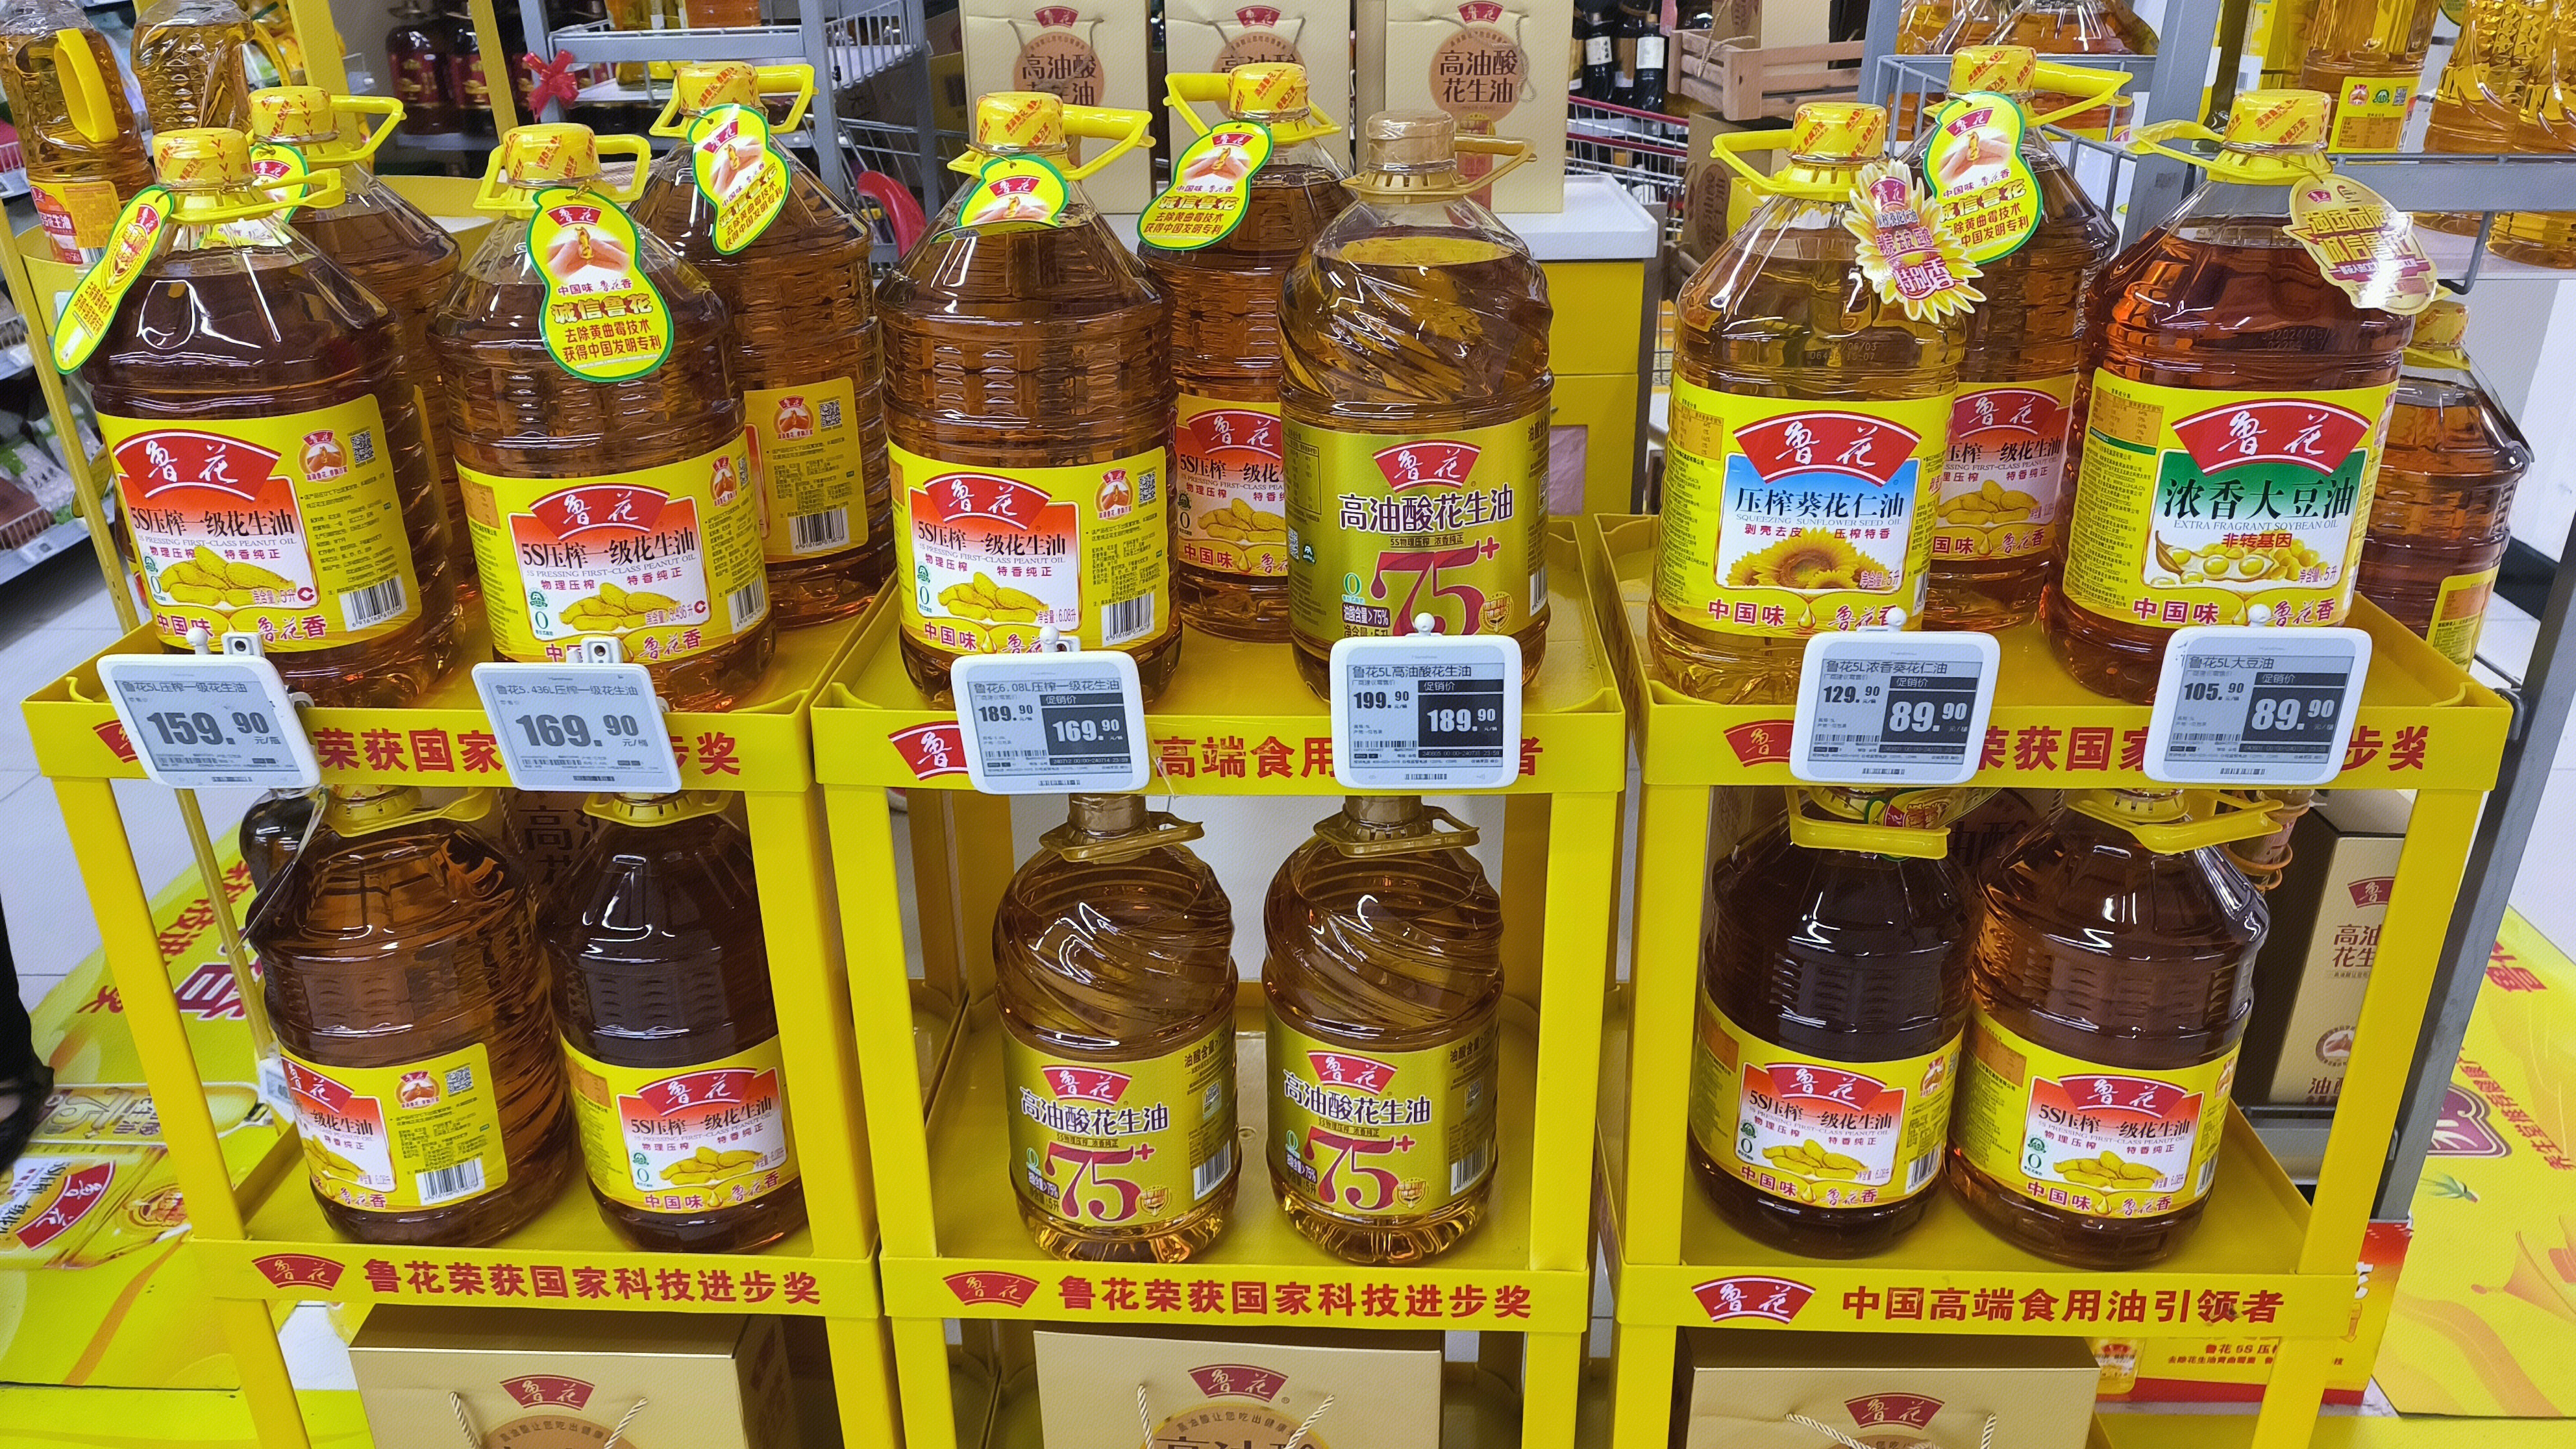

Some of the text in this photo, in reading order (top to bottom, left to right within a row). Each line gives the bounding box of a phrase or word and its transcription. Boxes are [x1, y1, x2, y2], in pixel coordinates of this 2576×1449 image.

[1042, 9, 1072, 25] 鲁花
[1245, 8, 1280, 26] 鲁花
[1468, 5, 1496, 20] 鲁花
[1021, 53, 1097, 81] 高油酸
[1440, 50, 1518, 75] 高油酸
[1443, 77, 1513, 103] 花生油
[1956, 111, 1986, 132] 鲁花
[1217, 135, 1247, 144] 鲁花
[723, 186, 742, 206] 中国味
[998, 179, 1030, 194] 鲁花
[1873, 183, 1903, 202] 鲁花
[1944, 182, 1974, 197] 中国味
[559, 208, 594, 222] 鲁花
[1158, 195, 1239, 210] 诚信鲁花
[1143, 223, 1223, 234] 获得中国发明专利
[1155, 212, 1224, 223] 去除黄曲霉技术
[558, 279, 632, 295] 中国味 鲁花香
[1892, 256, 1955, 293] 特别香
[552, 293, 653, 324] 诚信鲁花
[565, 319, 650, 343] 去除黄曲霉技术
[563, 334, 662, 363] 获得中国发明专利
[1969, 395, 2037, 425] 鲁花
[1211, 415, 1274, 448] 鲁花
[2218, 410, 2324, 456] 鲁花
[1776, 420, 1876, 469] 鲁花
[145, 440, 238, 484] 鲁花
[1394, 449, 1461, 482] 鲁花
[2007, 467, 2048, 480] 特香纯正
[1187, 482, 1226, 499] 物理压榨
[1188, 476, 1218, 486] PRESSING
[563, 491, 638, 527] 鲁花
[948, 479, 1017, 517] 鲁花
[1339, 483, 1513, 534] 高油酸花生油
[1735, 488, 1904, 518] 压榨葵花仁油
[2164, 478, 2354, 521] 浓香大豆油
[131, 507, 295, 537] 5S压榨一级花生油
[1736, 514, 1791, 523] SQUEEZING
[1797, 518, 1856, 526] SUNFLOWER
[1745, 524, 1890, 539] 剥壳去皮 压榨特香
[2174, 520, 2210, 529] EXTRA
[2214, 521, 2271, 530] FRAGRANT
[2275, 520, 2322, 530] SOYBEAN
[145, 536, 180, 545] PRESSING
[521, 527, 695, 569] 5S压榨一级花生油
[918, 521, 1065, 556] 5S压榨一级花生油
[1391, 534, 1464, 547] 5S物理压榨 浓香纯正
[1997, 528, 2044, 554] 鲁花香
[2222, 533, 2292, 548] 非转基因
[225, 549, 280, 560] 特香纯正
[582, 565, 641, 576] FIRST-CLASS
[644, 558, 679, 571] PEANUT
[925, 553, 1052, 576] 物理压榨 特香纯正
[926, 545, 958, 558] PRESSING
[960, 554, 1011, 564] FIRST-CLASS
[1184, 543, 1233, 569] 中国味
[541, 567, 682, 589] 物理压榨 特香纯正
[1708, 599, 1785, 626] 中国味
[2133, 597, 2335, 626] 中国味 鲁花香
[256, 615, 327, 643] 鲁花香
[924, 622, 976, 650] 中国味
[638, 628, 702, 661] 鲁花香
[1352, 665, 1471, 678] 鲁花5L高油酸花生油
[1826, 661, 1947, 674] 鲁花5L浓香葵花仁油
[2189, 657, 2274, 669] 鲁花5L大豆油
[123, 681, 247, 693] 鲁花5L压榨一级花生油
[496, 684, 638, 696] 鲁花5.436L压榨一级花生油
[974, 680, 1120, 693] 鲁花6.08L压榨一级花生油
[1424, 682, 1455, 691] 促销价
[1896, 678, 1928, 687] 促销价
[2262, 675, 2296, 684] 促销价
[1046, 695, 1076, 704] 促销价
[2334, 924, 2381, 946] 高油
[2333, 947, 2375, 968] 花生
[288, 1063, 330, 1101] 鲁花
[1322, 1056, 1379, 1087] 鲁花
[1790, 1067, 1855, 1100] 鲁花
[667, 1074, 730, 1104] 鲁花
[1057, 1071, 1113, 1098] 鲁花
[1283, 1069, 1431, 1125] 高油酸花生油
[2087, 1078, 2159, 1109] 鲁花
[631, 1095, 771, 1136] 5S压榨一级花生油
[1020, 1086, 1169, 1136] 高油酸花生油
[1749, 1090, 1892, 1130] 5S压榨一级花生油
[2038, 1104, 2190, 1139] 5S压榨一级花生油
[732, 1117, 759, 1131] PEANUT
[340, 1187, 386, 1208] 鲁花香
[645, 1171, 779, 1209] 中国味 鲁花香
[1742, 1166, 1877, 1206] 中国味 鲁花香
[2027, 1182, 2172, 1215] 中国味 鲁花香
[274, 1258, 822, 1305] 鲁花 鲁花荣获国家科技进步奖
[966, 1276, 1532, 1319] 鲁花 鲁花荣获国家科技进步奖
[1713, 1284, 2285, 1326] 鲁花 中国高端食用油引领者
[522, 1380, 581, 1403] 鲁花
[1208, 1369, 1270, 1394] 鲁花
[1861, 1399, 1930, 1425] 鲁花
